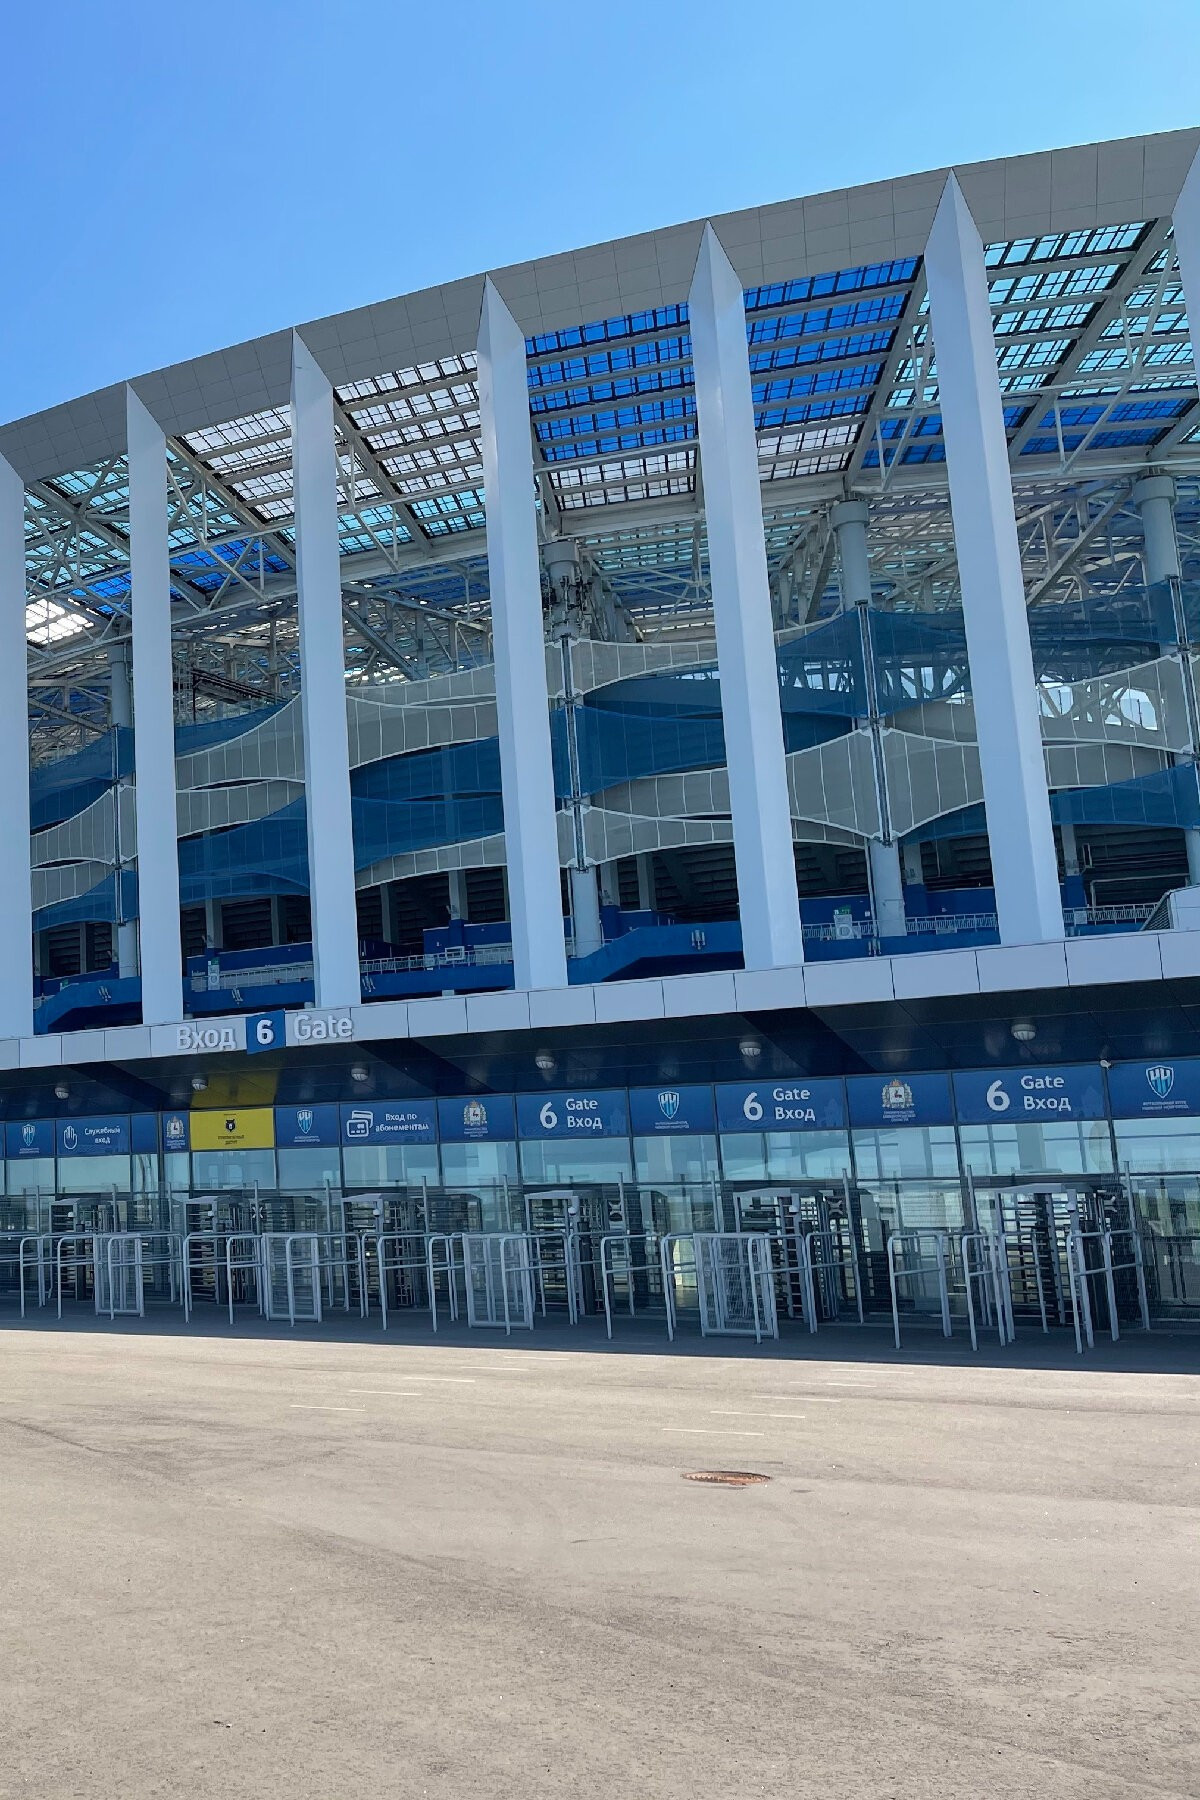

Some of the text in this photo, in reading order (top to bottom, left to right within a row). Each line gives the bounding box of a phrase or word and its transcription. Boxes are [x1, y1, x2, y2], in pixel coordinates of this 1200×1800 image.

[176, 1014, 355, 1051] Вход 6 Gate
[1020, 1075, 1065, 1090] Gate
[773, 1087, 810, 1102] Gate
[986, 1080, 1011, 1112] 6
[565, 1098, 598, 1112] Gate
[743, 1092, 763, 1121] 6
[1023, 1095, 1072, 1112] Вход
[385, 1112, 418, 1123] Вход по
[539, 1101, 558, 1130] 6
[774, 1105, 815, 1122] Вход
[375, 1122, 430, 1133] абонементам
[566, 1114, 602, 1130] Вход
[84, 1125, 121, 1138] Служебный
[94, 1136, 111, 1145] вход
